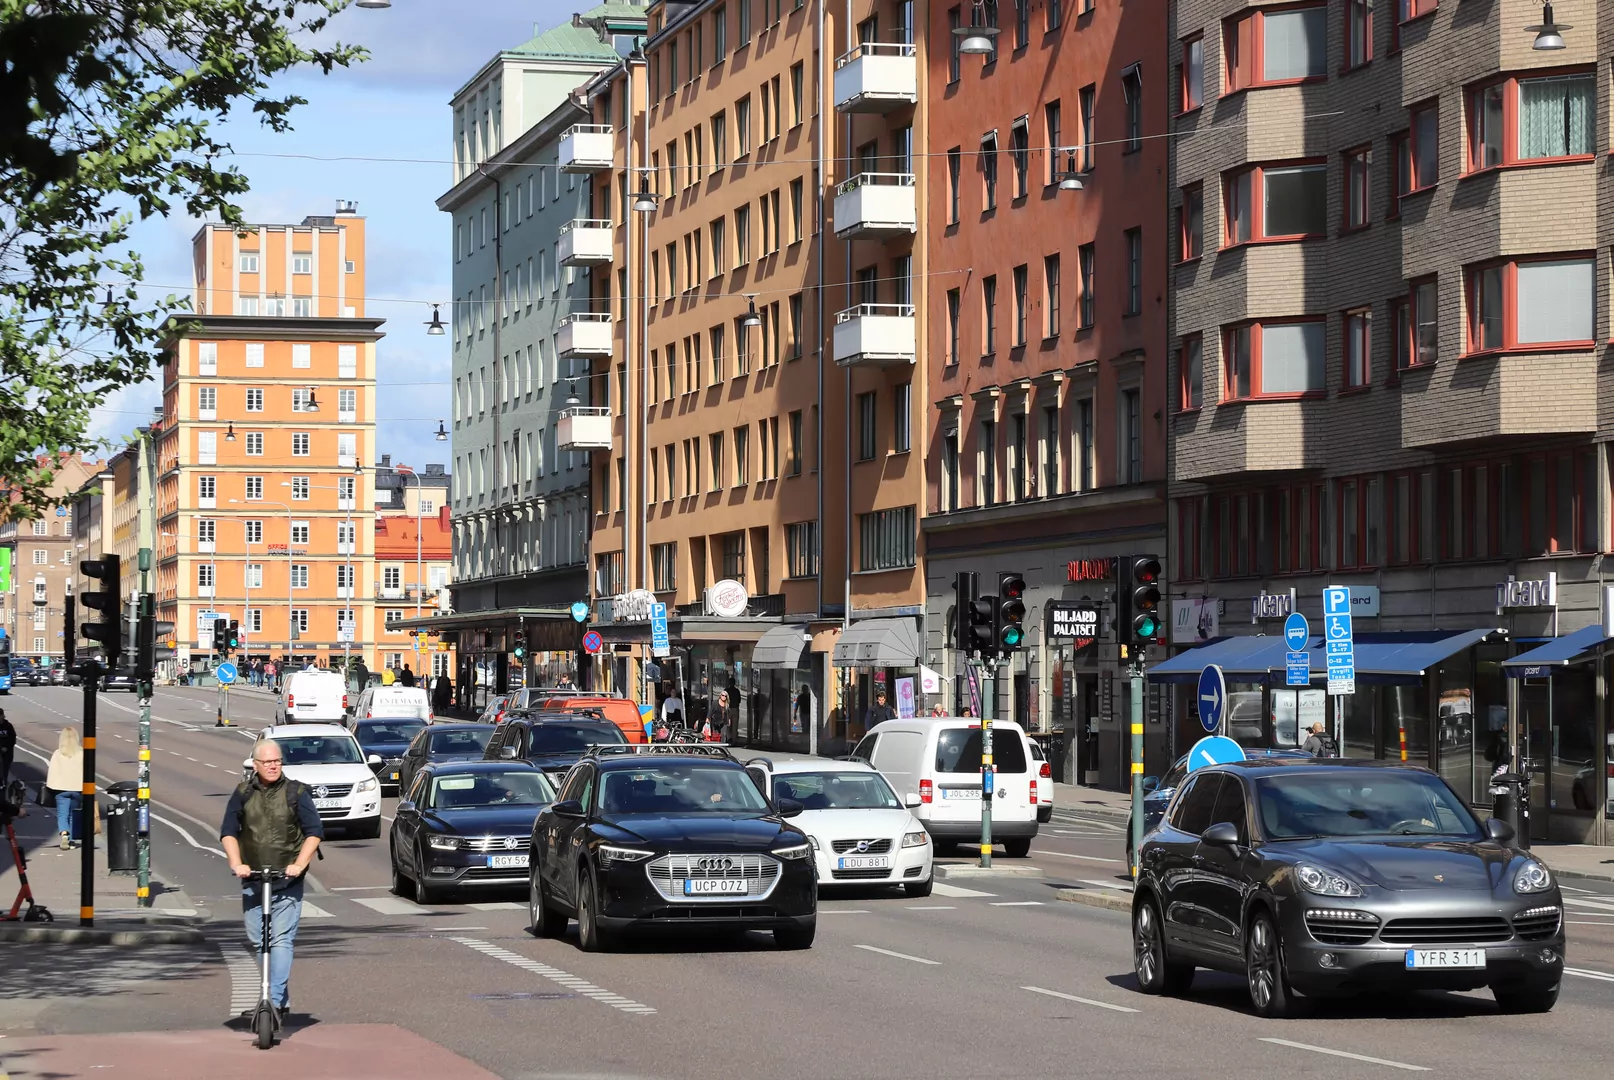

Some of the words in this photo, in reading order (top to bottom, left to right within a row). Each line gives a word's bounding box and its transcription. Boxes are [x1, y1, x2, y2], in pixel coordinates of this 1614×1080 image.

[1496, 572, 1556, 615] picard
[1330, 591, 1345, 612] P
[1350, 596, 1371, 604] ard
[655, 604, 663, 616] P
[1251, 588, 1296, 624] picard
[1053, 610, 1097, 622] BILJARD
[1053, 624, 1097, 635] PALATSET
[1525, 666, 1540, 676] picard
[949, 790, 964, 798] JOL
[965, 790, 980, 798] 295
[495, 857, 512, 865] RGY
[844, 859, 861, 868] LDU
[868, 858, 886, 867] 881
[695, 881, 717, 891] UCP
[721, 881, 743, 891] 07Z
[1420, 952, 1447, 964] YFR
[1452, 952, 1478, 964] 311
